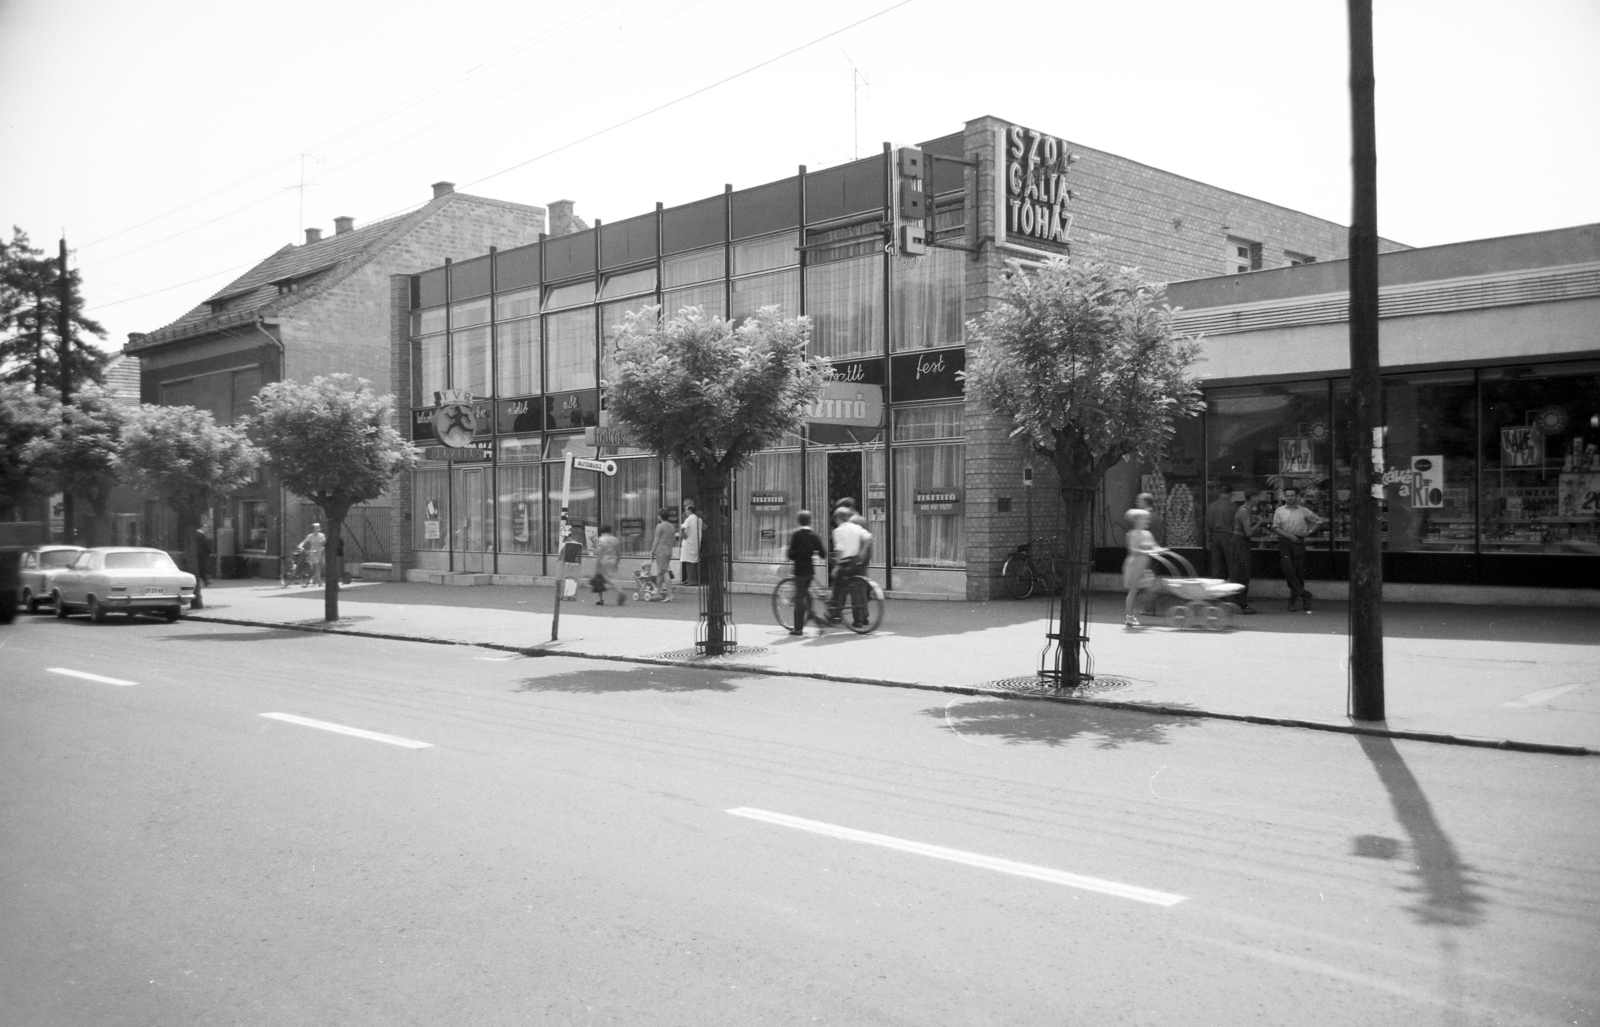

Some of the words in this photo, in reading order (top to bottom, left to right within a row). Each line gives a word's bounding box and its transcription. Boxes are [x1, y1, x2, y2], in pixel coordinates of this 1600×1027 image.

[1009, 197, 1075, 243] TÓHÁZ
[915, 353, 947, 380] fest
[1398, 484, 1410, 497] a
